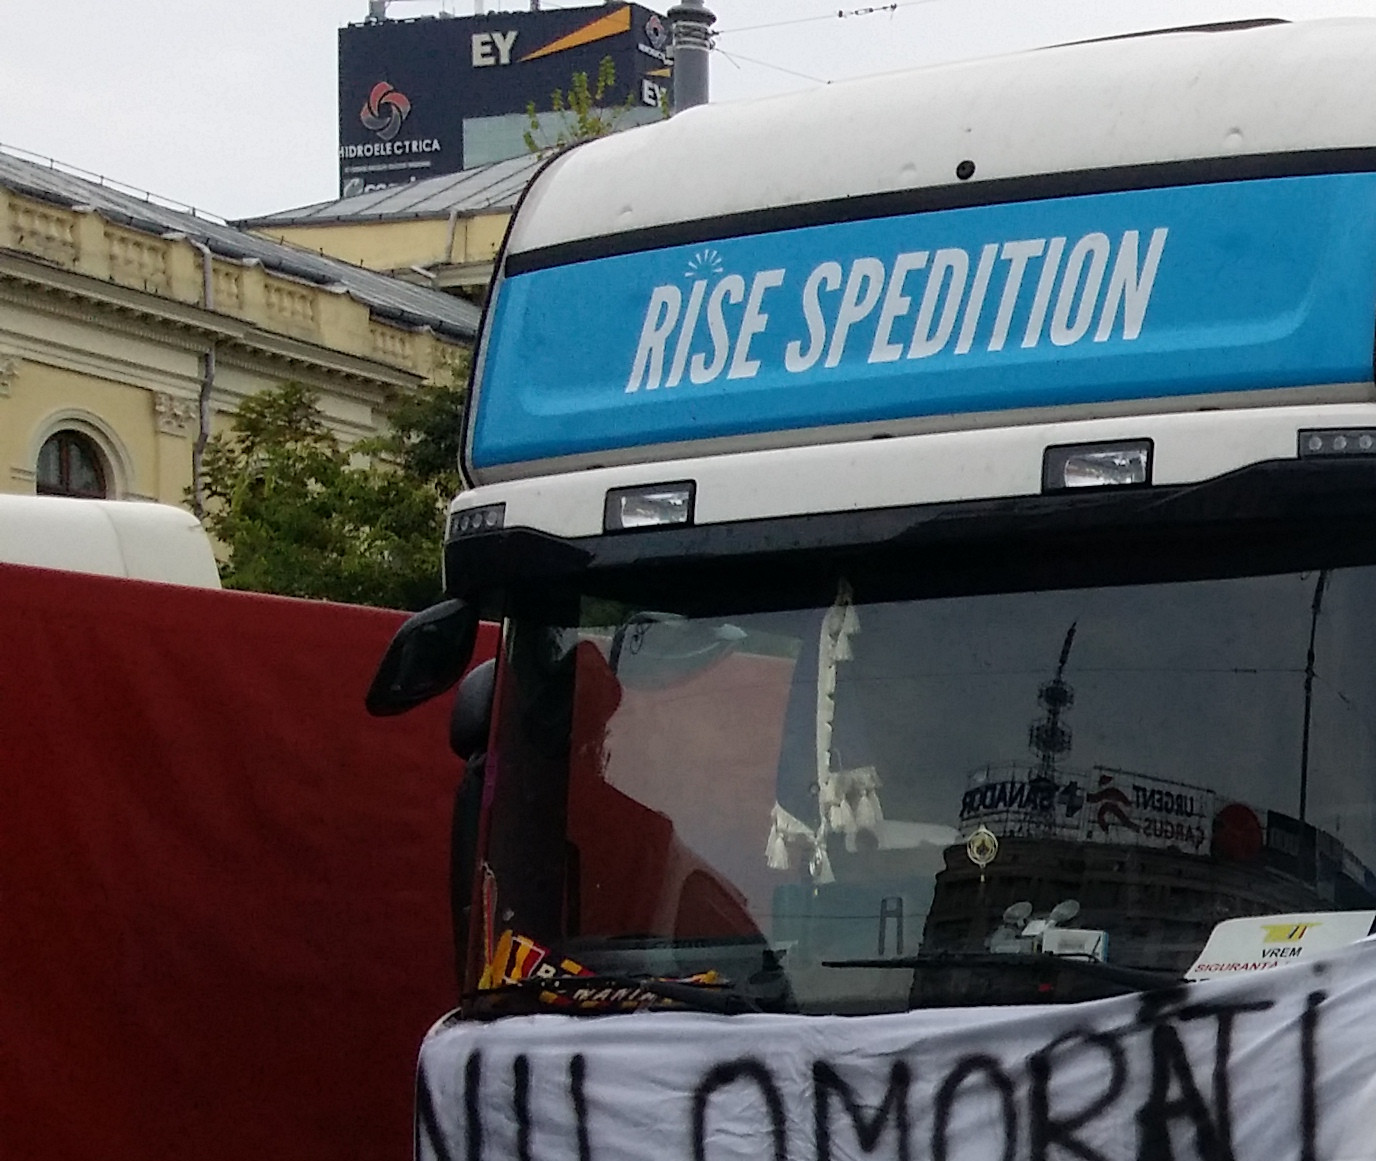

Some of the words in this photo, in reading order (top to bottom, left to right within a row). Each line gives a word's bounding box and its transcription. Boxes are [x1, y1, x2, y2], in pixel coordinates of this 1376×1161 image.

[471, 30, 519, 68] EY
[339, 139, 441, 159] HIDROELECTRICA
[625, 267, 787, 394] RISE
[784, 226, 1169, 373] SPEDITION
[1261, 946, 1303, 959] VREM
